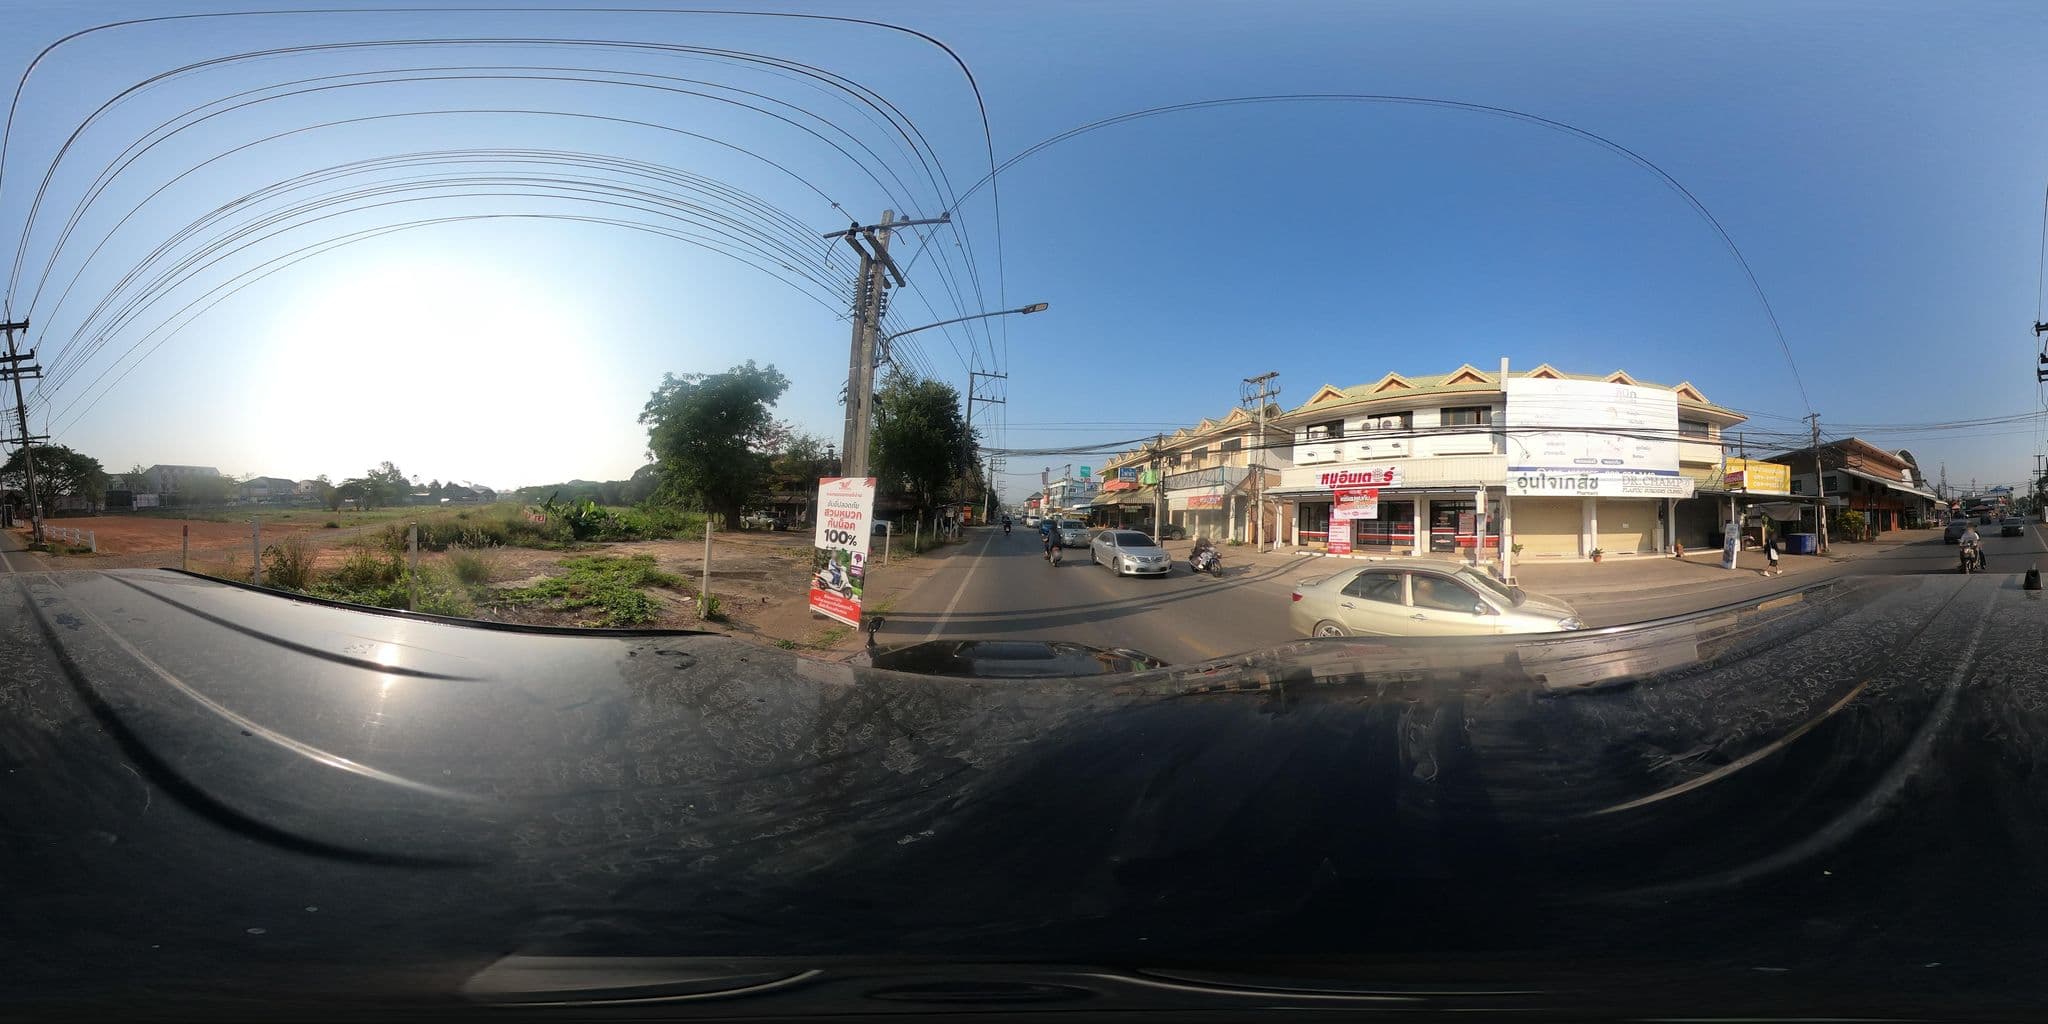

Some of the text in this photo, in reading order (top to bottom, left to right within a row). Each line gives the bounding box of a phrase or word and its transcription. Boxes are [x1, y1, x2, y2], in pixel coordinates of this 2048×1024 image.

[1517, 472, 1599, 494] อุ่นใจเภสัช
[824, 508, 862, 520] สวมหมวก
[824, 528, 857, 546] 100%
